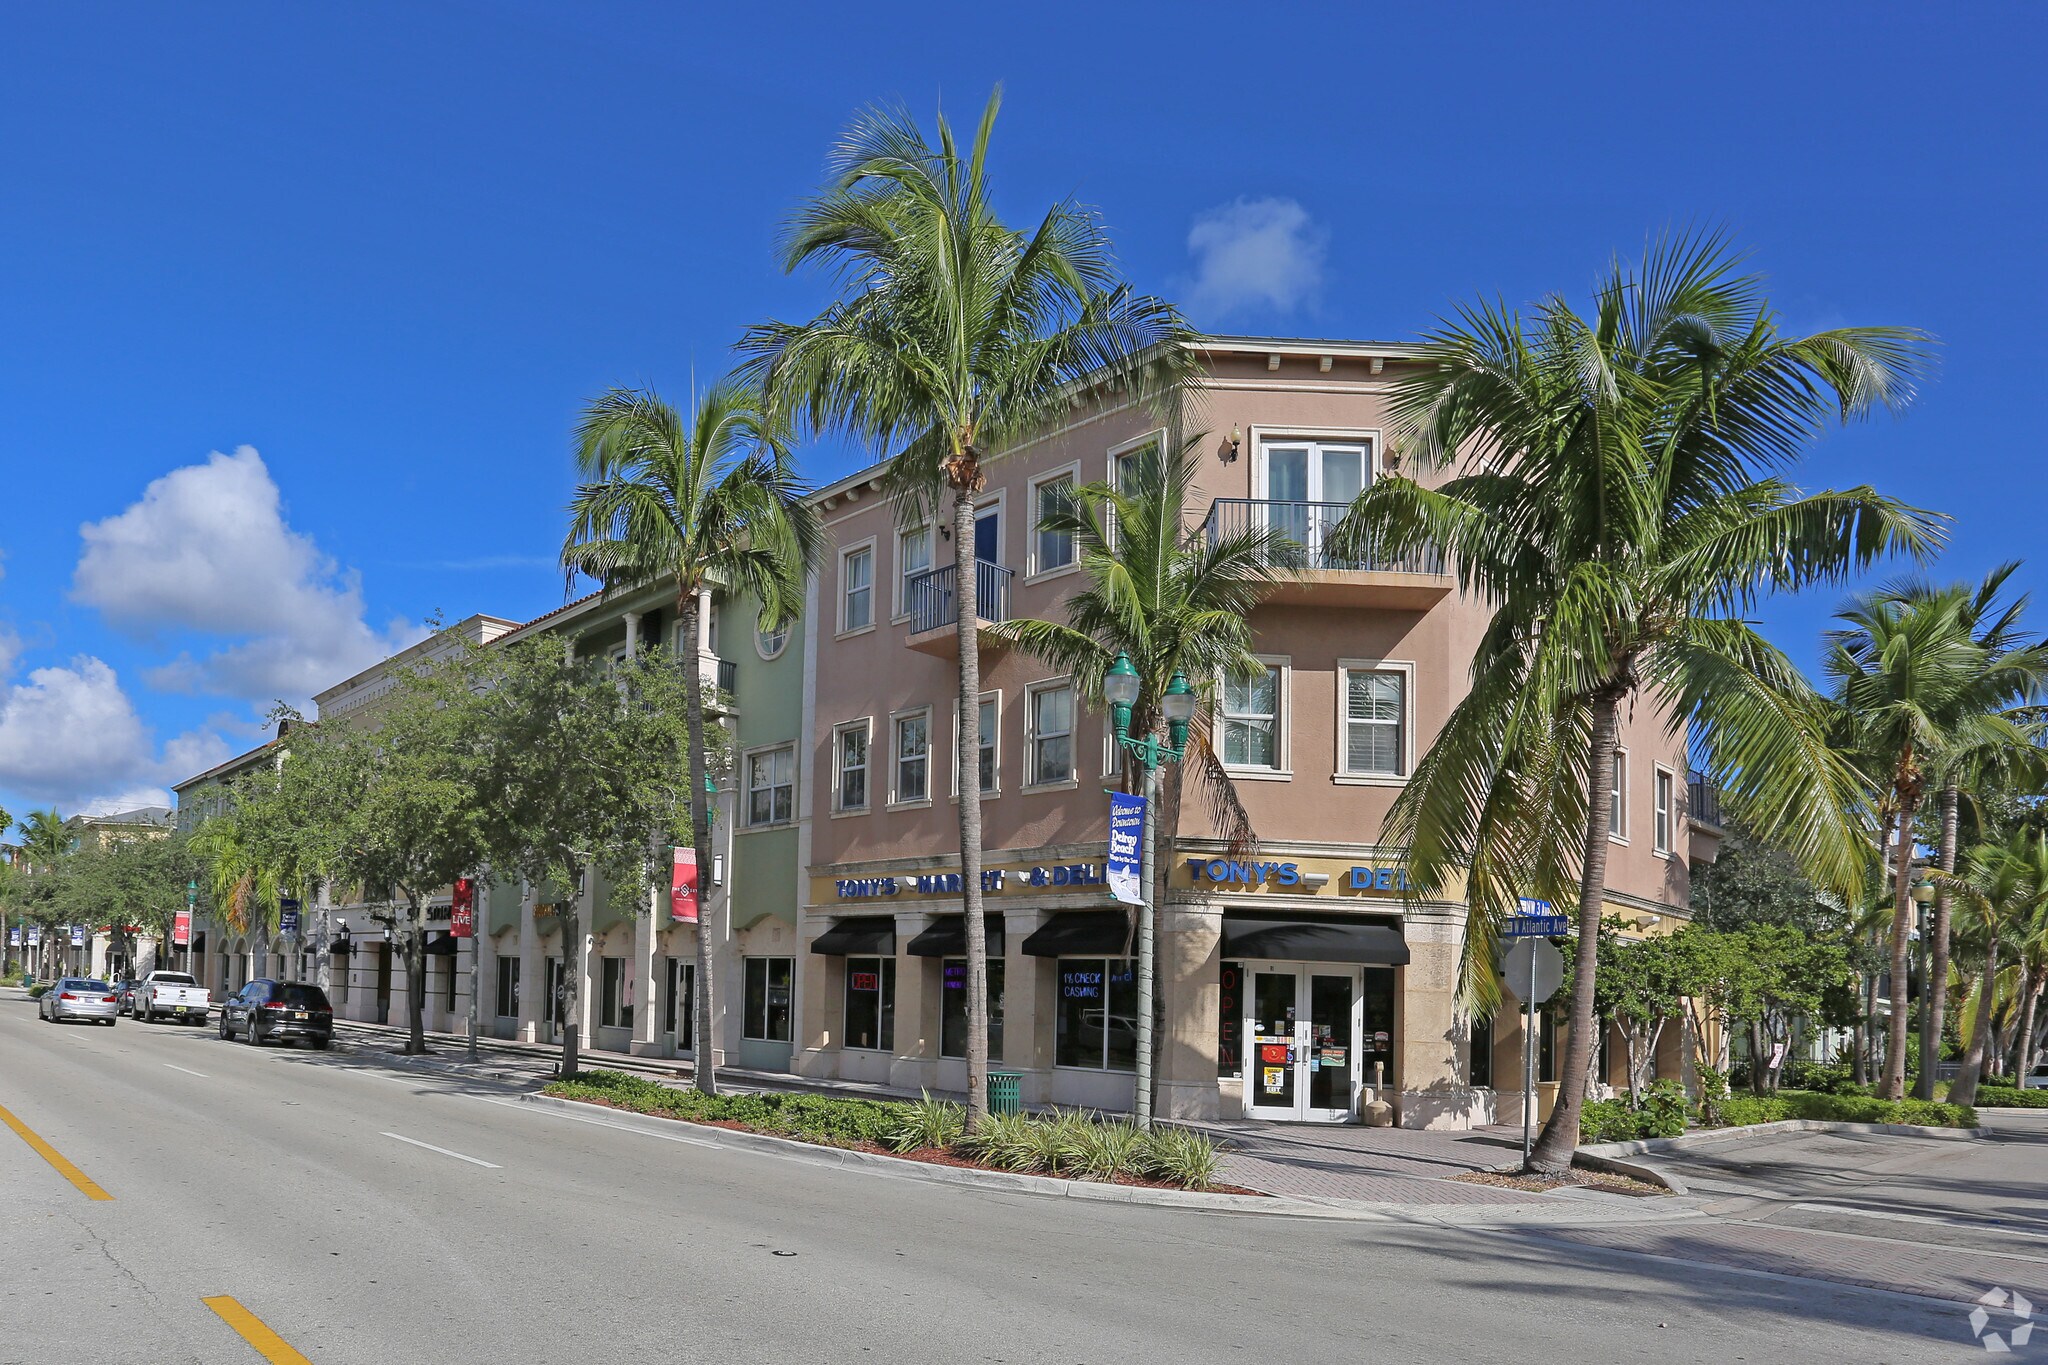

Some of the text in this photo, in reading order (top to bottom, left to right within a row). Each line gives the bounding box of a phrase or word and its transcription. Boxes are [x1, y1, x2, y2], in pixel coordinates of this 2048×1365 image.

[1112, 816, 1140, 828] Downtown
[1111, 829, 1137, 847] Delray
[1110, 840, 1134, 855] Beach
[836, 863, 1109, 898] TONY'S MARET & DELI
[1187, 857, 1425, 891] TONY'S DEL
[452, 915, 471, 925] LIVE
[1522, 919, 1551, 933] Atlantic
[1553, 918, 1567, 933] Ave
[1074, 972, 1101, 984] CHECK
[1064, 986, 1099, 998] CASHING
[1222, 970, 1236, 1067] OPEN
